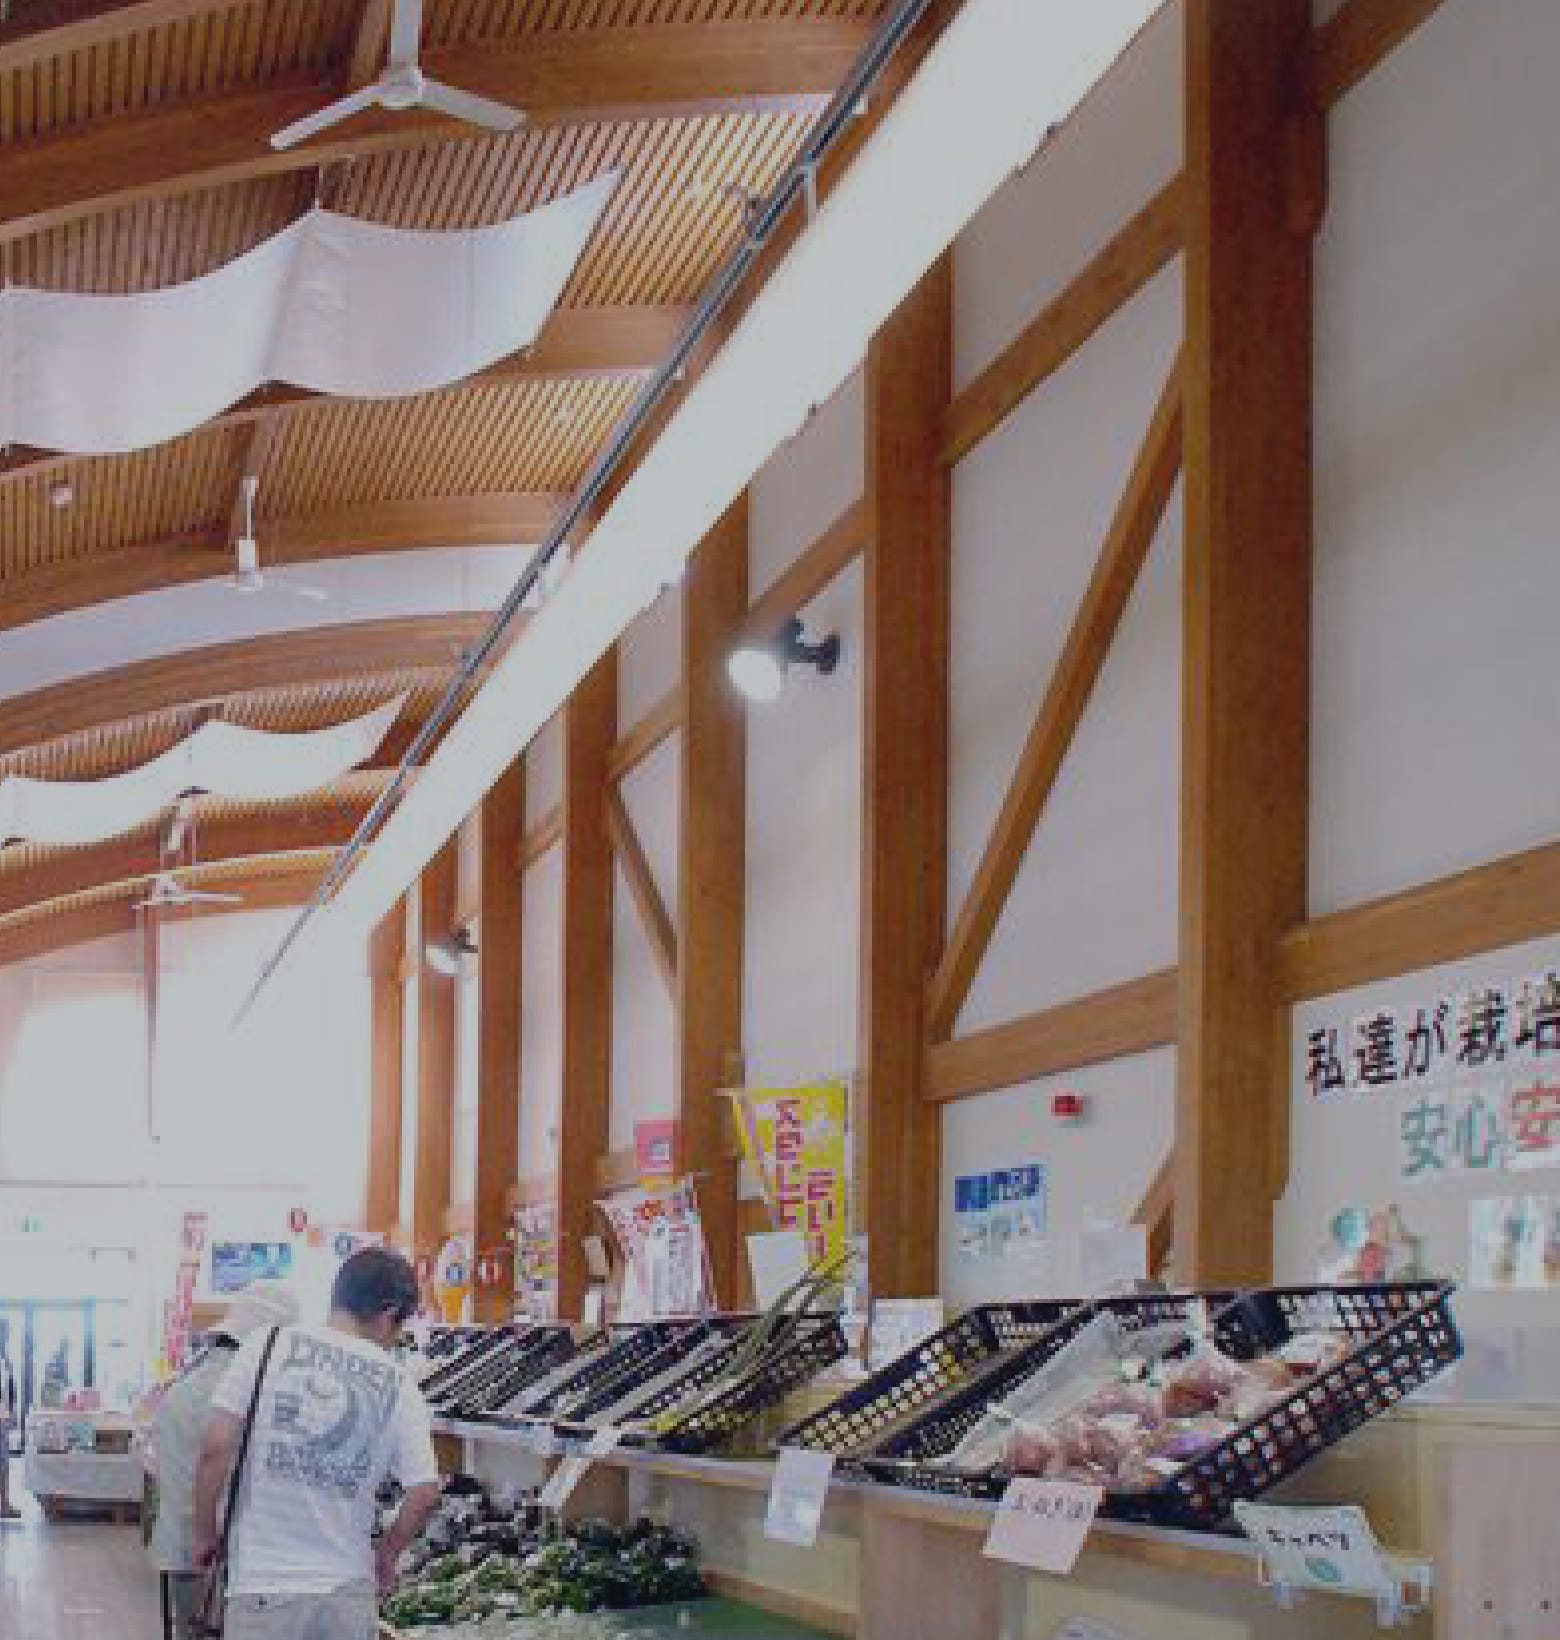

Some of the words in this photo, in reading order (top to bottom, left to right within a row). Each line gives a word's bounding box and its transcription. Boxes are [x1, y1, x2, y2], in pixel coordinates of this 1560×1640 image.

[1304, 970, 1560, 1097] 私達が栽培
